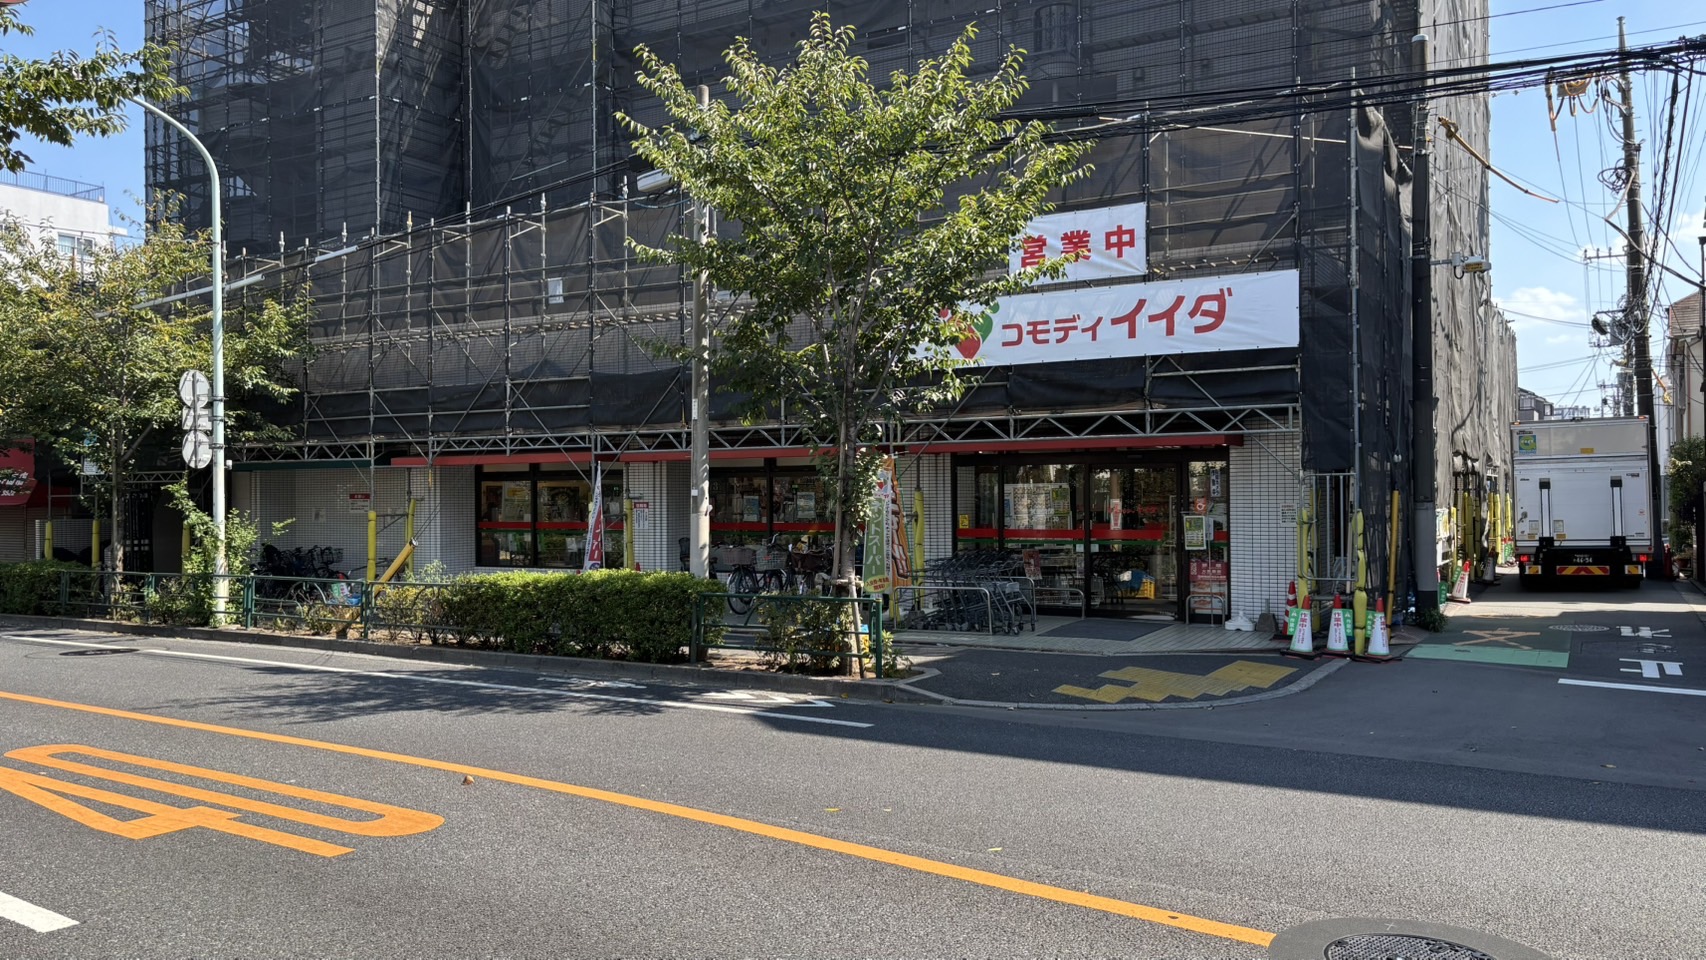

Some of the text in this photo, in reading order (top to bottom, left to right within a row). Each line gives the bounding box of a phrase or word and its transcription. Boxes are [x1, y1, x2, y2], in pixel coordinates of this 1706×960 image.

[1020, 224, 1136, 268] 営業中
[1001, 287, 1233, 348] コモディイイダ
[866, 500, 883, 575] ネットスーパー
[1333, 612, 1342, 628] 作業中
[0, 743, 446, 858] 40
